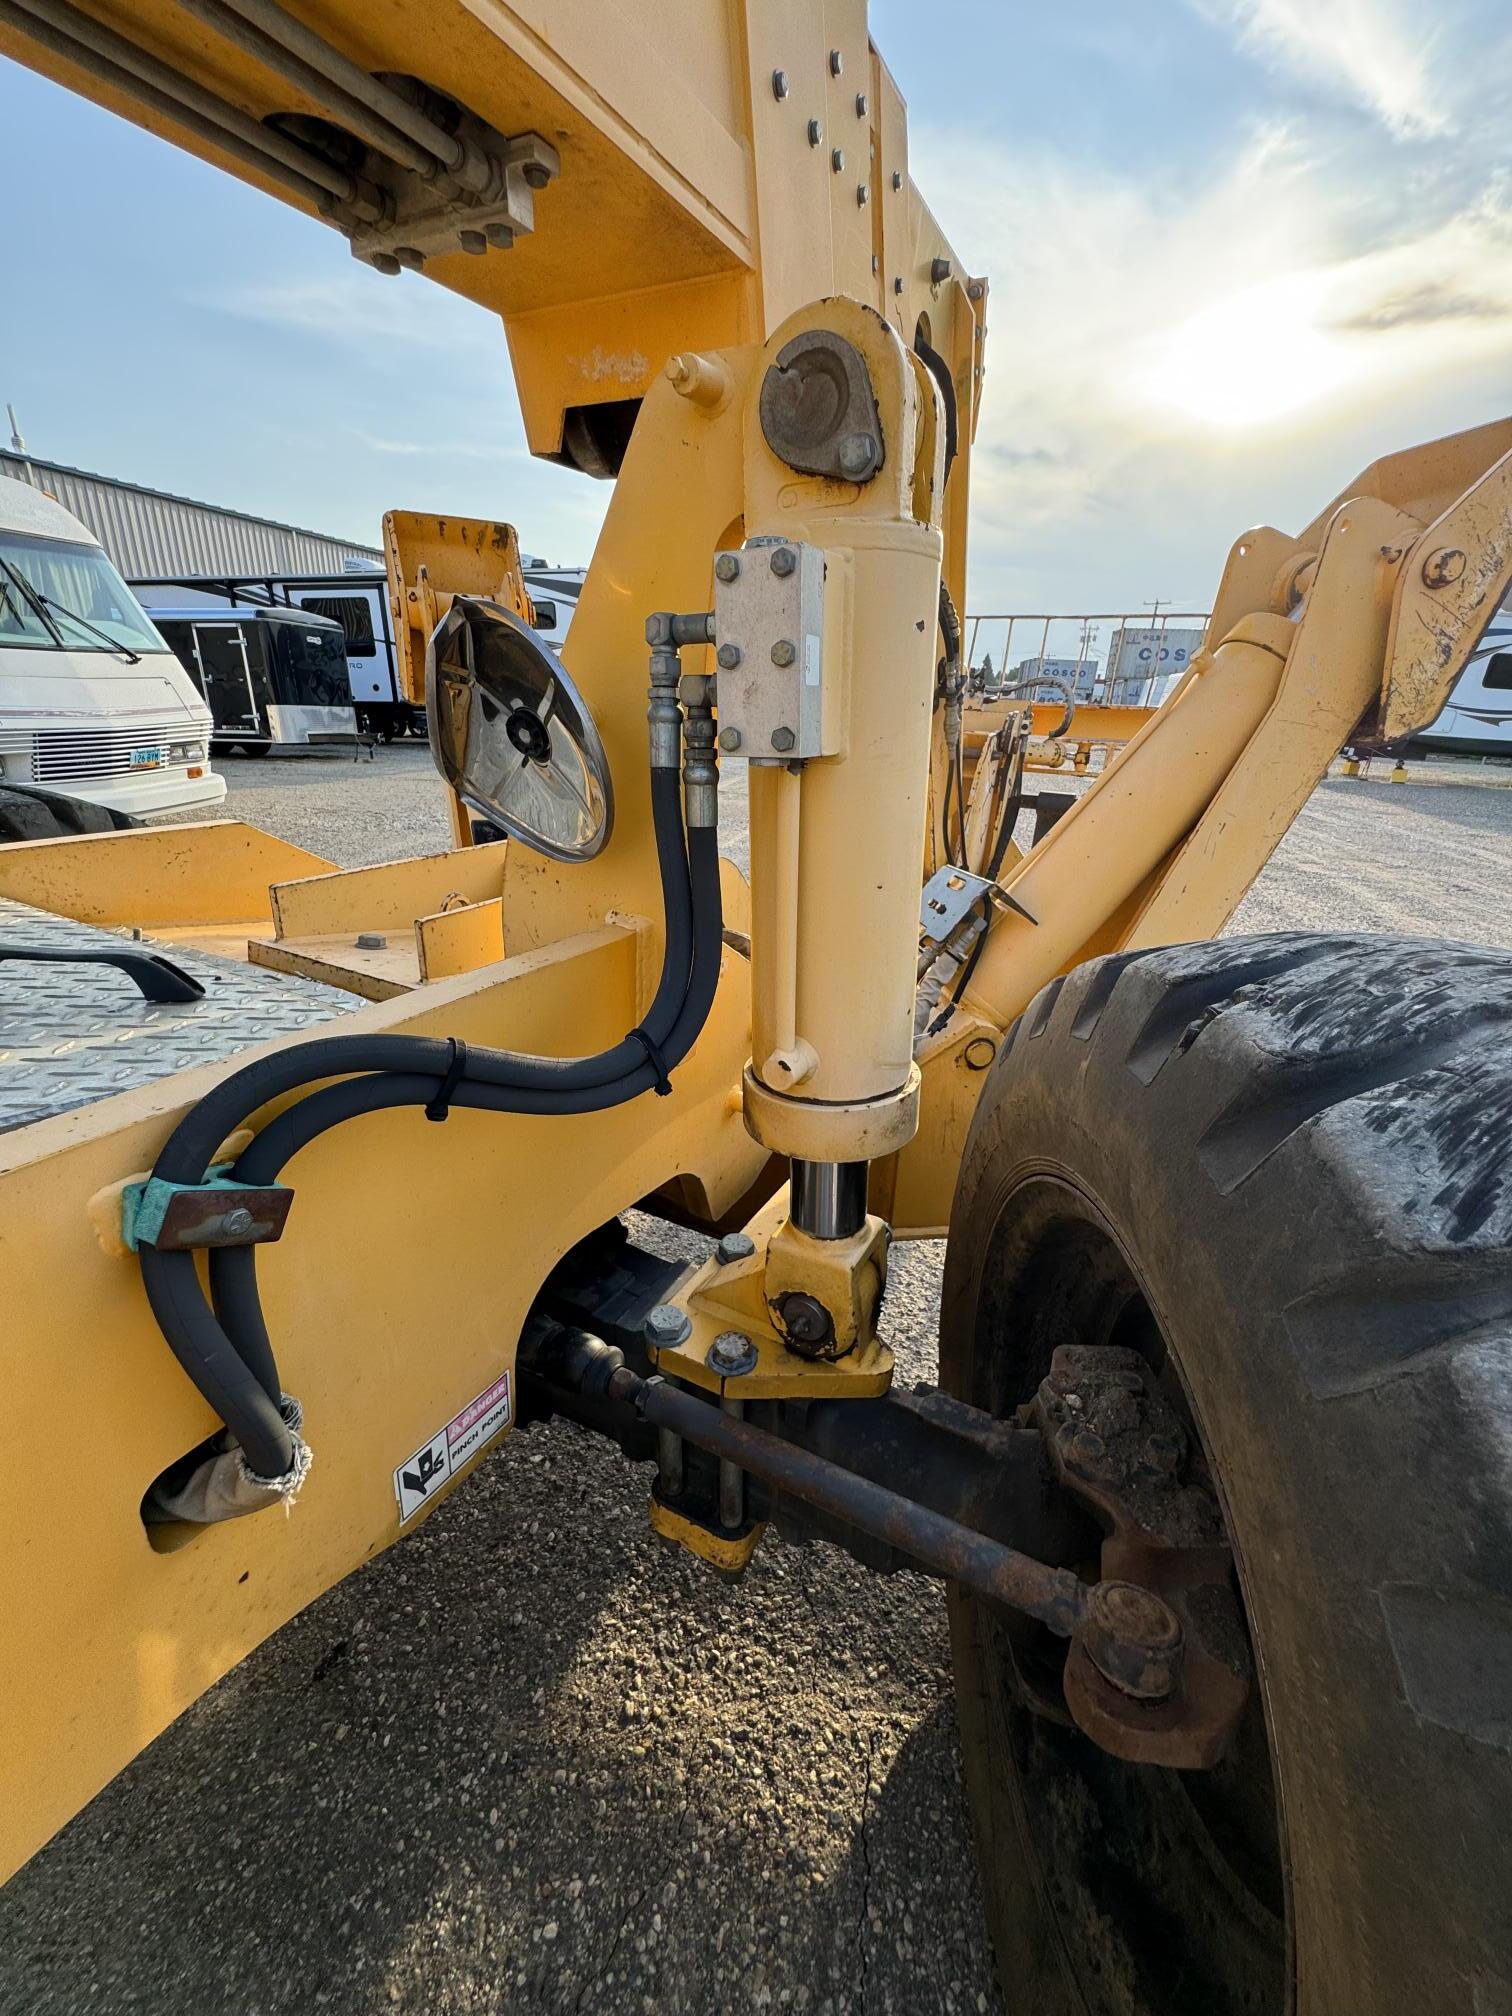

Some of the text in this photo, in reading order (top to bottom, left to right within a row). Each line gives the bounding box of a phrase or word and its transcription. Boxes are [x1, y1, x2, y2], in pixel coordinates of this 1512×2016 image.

[1138, 647, 1187, 662] COS
[1043, 668, 1086, 678] COSCO
[462, 1383, 505, 1427] DANGER
[451, 1404, 506, 1460] PINCH POINT
